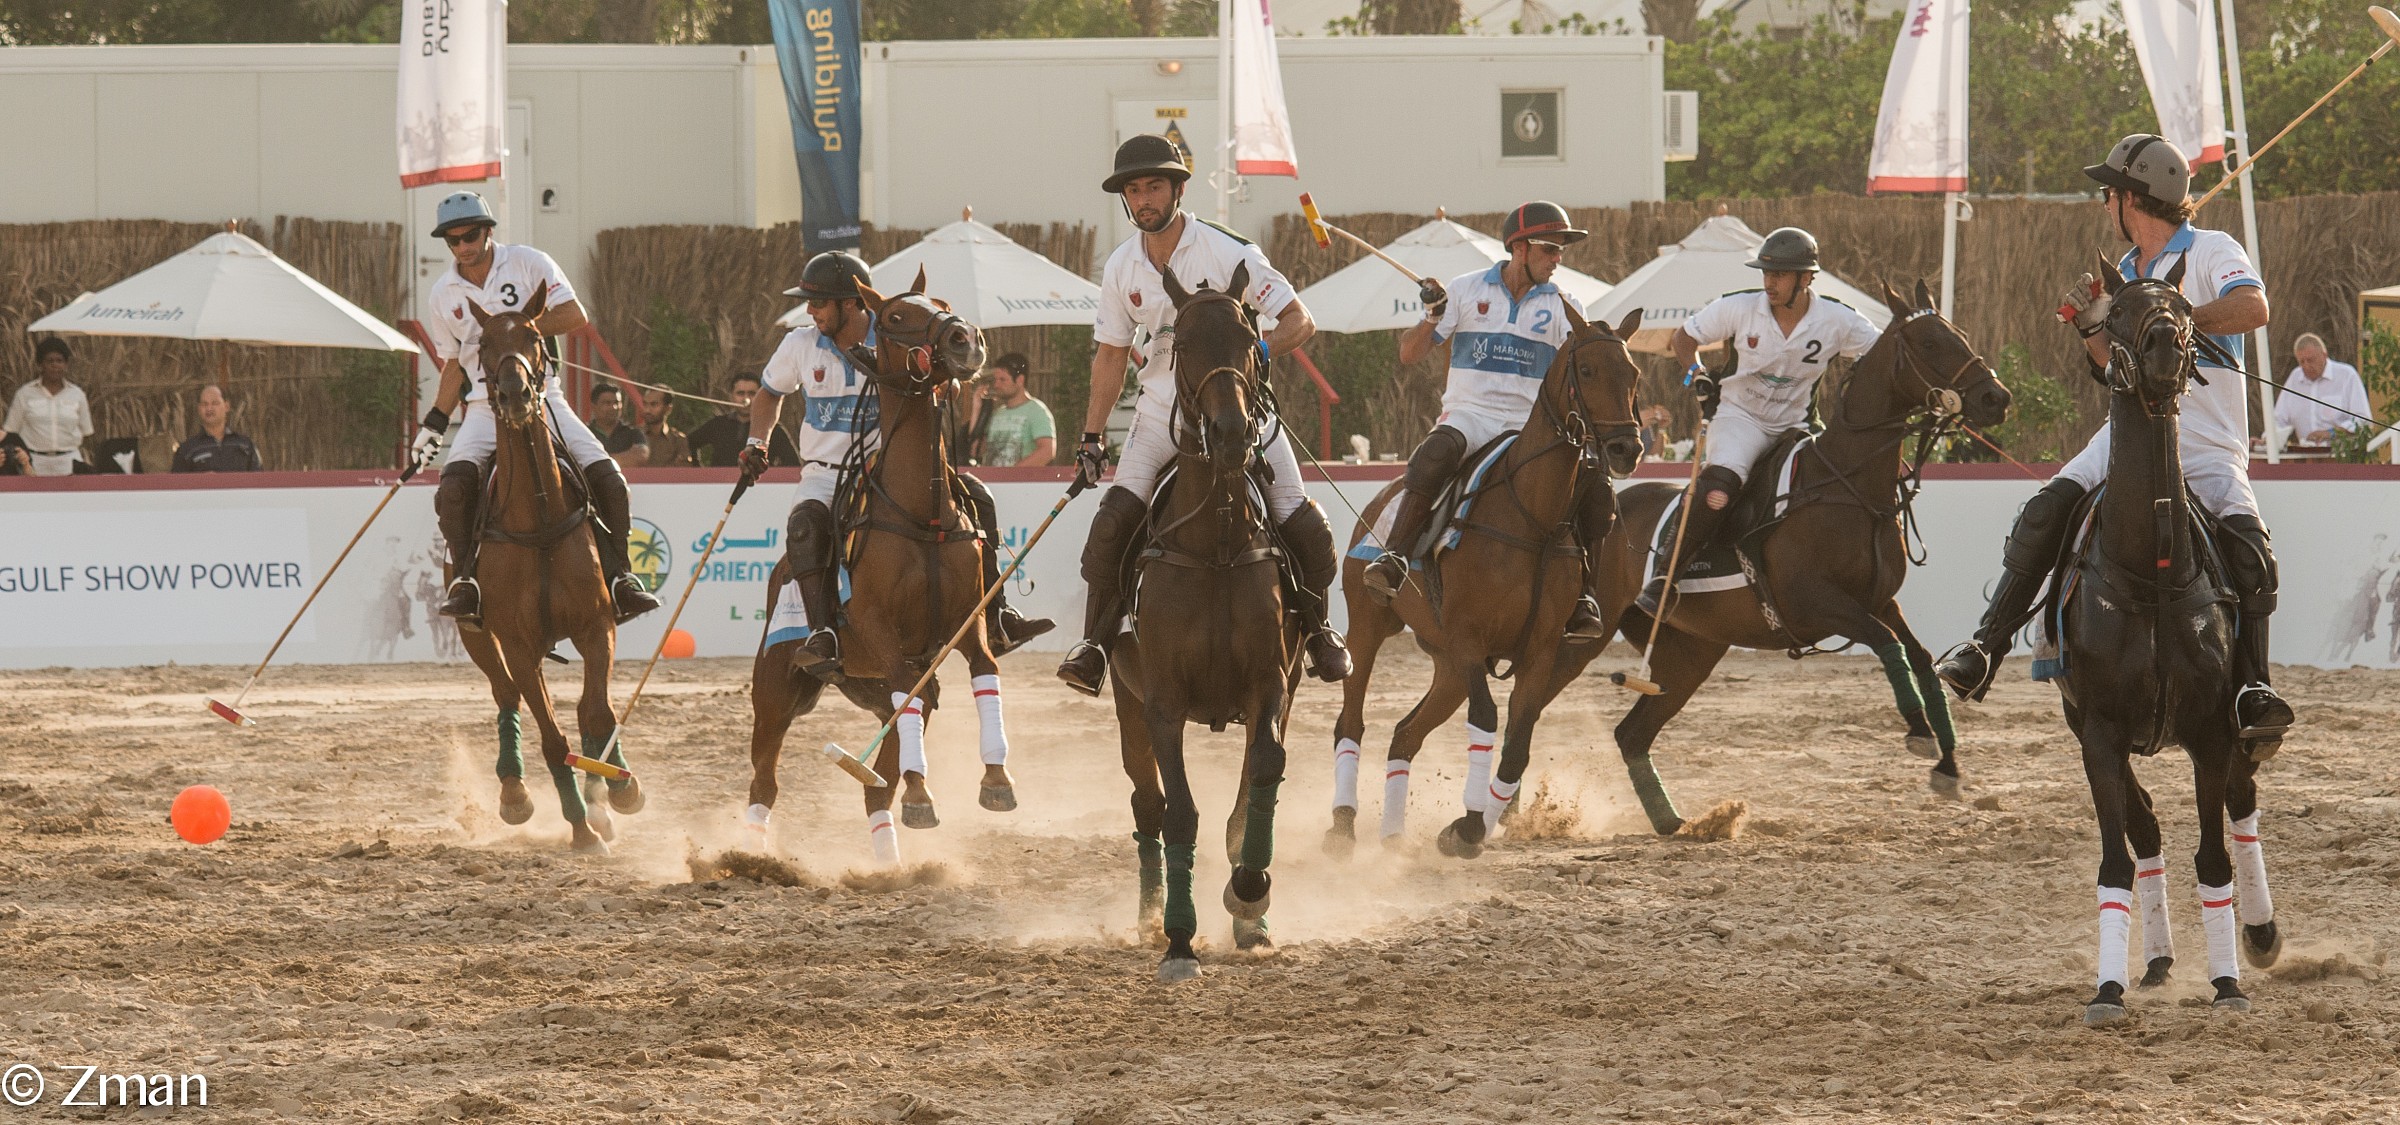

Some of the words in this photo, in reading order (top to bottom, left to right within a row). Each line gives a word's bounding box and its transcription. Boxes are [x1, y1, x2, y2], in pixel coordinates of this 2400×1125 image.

[1157, 109, 1186, 118] MALE
[500, 283, 519, 307] 3
[78, 303, 184, 321] Jumeirah
[1531, 309, 1553, 335] 2
[1801, 339, 1822, 364] 2
[0, 567, 74, 593] GULF
[84, 564, 180, 592] SHOW
[190, 562, 303, 589] POWER
